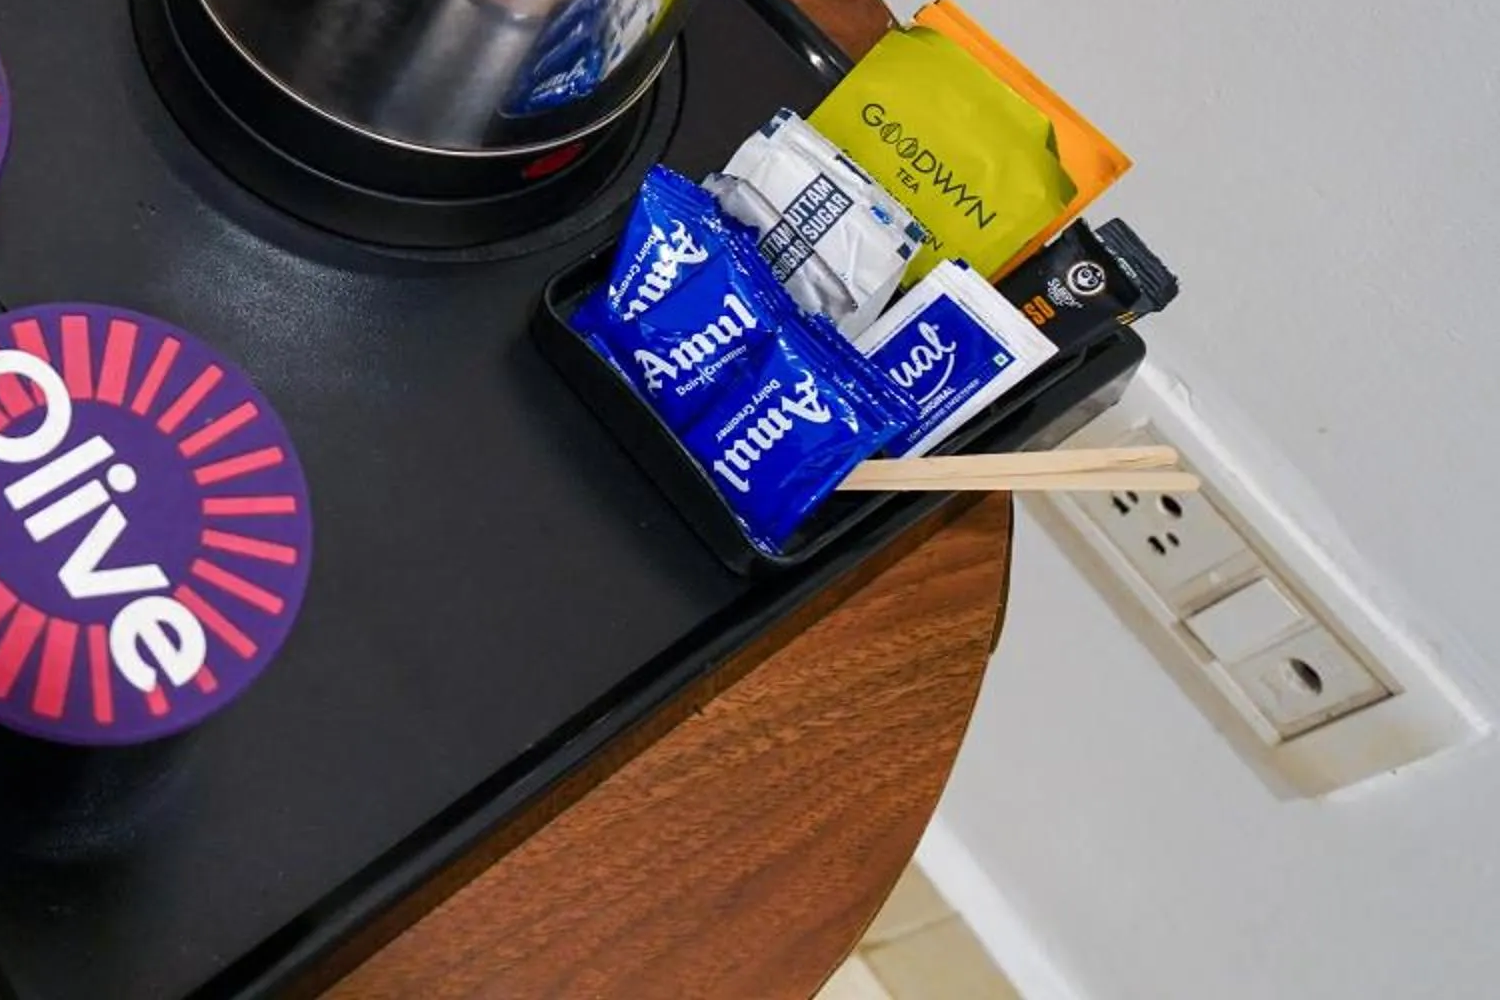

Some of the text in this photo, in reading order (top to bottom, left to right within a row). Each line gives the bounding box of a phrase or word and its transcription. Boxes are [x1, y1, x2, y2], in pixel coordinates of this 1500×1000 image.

[861, 103, 997, 230] GOODWYN
[896, 167, 921, 194] TEA
[785, 178, 835, 225] UTTAM
[802, 193, 848, 241] SUGAR
[633, 293, 758, 393] Amul
[889, 322, 957, 388] ual
[751, 378, 781, 405] Dairy
[713, 368, 832, 493] Amul
